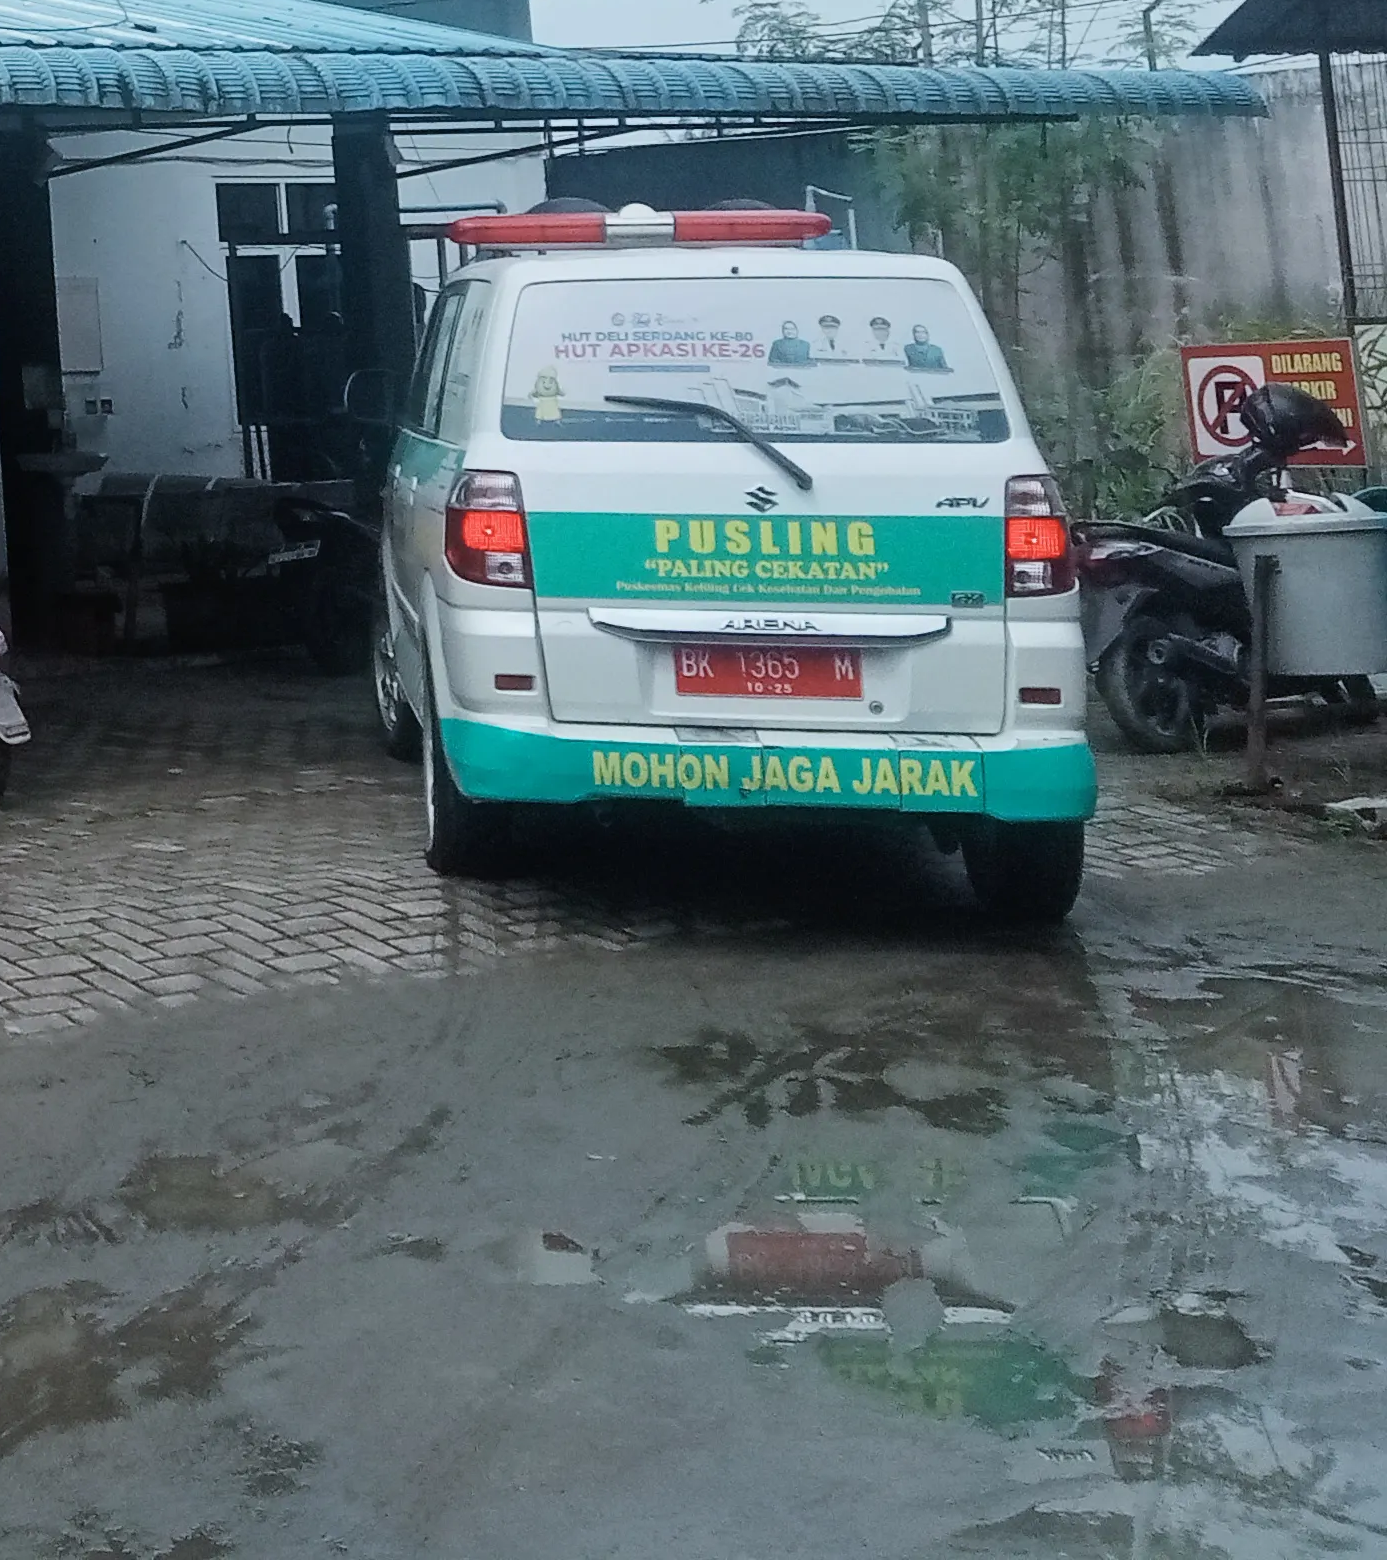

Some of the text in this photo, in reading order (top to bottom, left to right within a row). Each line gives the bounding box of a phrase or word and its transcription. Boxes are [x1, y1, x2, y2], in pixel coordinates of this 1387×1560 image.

[561, 331, 592, 342] HUT
[595, 331, 629, 341] DELI
[633, 330, 707, 341] SERDANG
[554, 342, 766, 359] HUT APKASI KE-26
[1271, 352, 1343, 374] DILARANG
[935, 497, 990, 509] APV
[654, 519, 876, 556] PUSLING
[616, 580, 682, 592] Puskesmas
[719, 618, 822, 632] ARENA
[681, 648, 855, 681] BK 1365 M
[592, 750, 978, 797] MOHON JAGA JARAK
